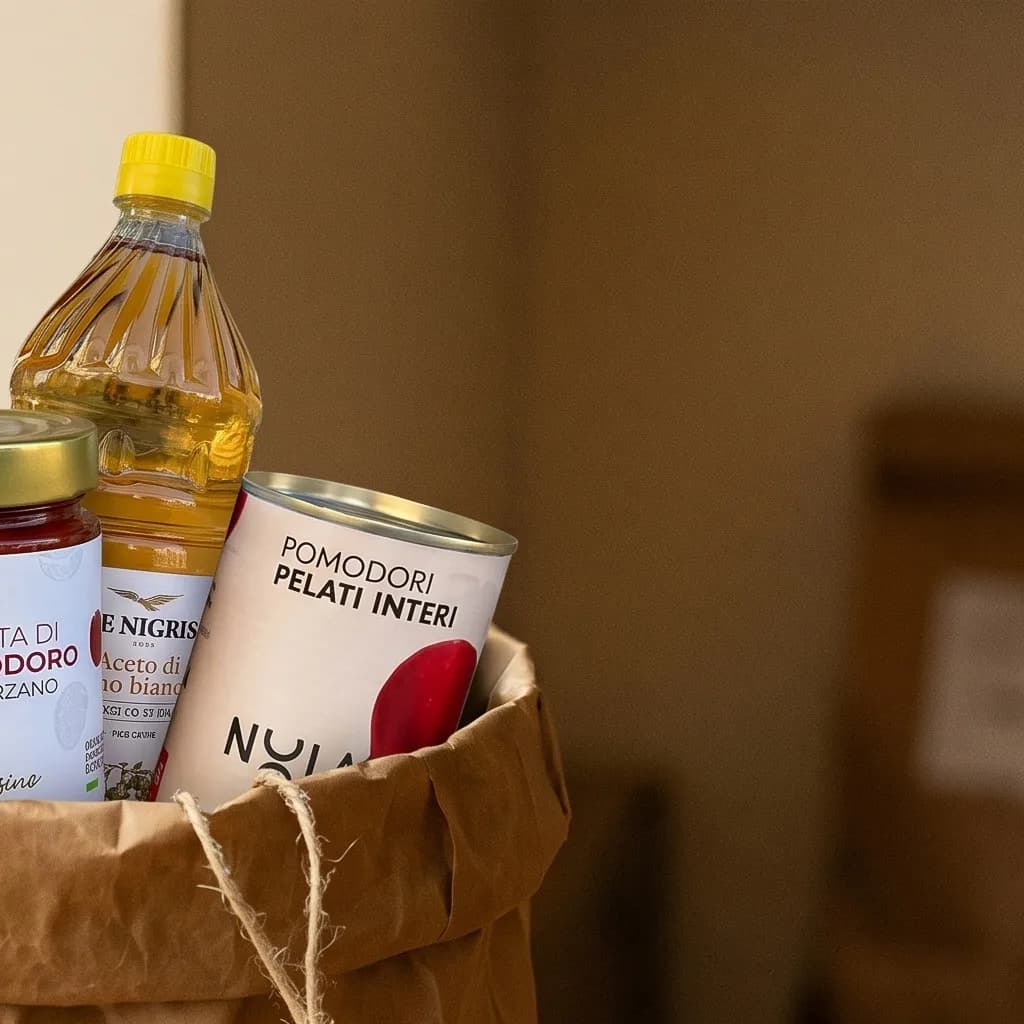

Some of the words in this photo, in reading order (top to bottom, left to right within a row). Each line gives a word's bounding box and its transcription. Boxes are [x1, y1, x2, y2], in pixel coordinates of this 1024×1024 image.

[280, 535, 435, 595] POMODORI
[273, 564, 363, 609] PELATI
[371, 590, 458, 628] INTERI
[35, 620, 59, 647] DI
[119, 615, 198, 640] NIGRIS
[162, 656, 180, 675] di
